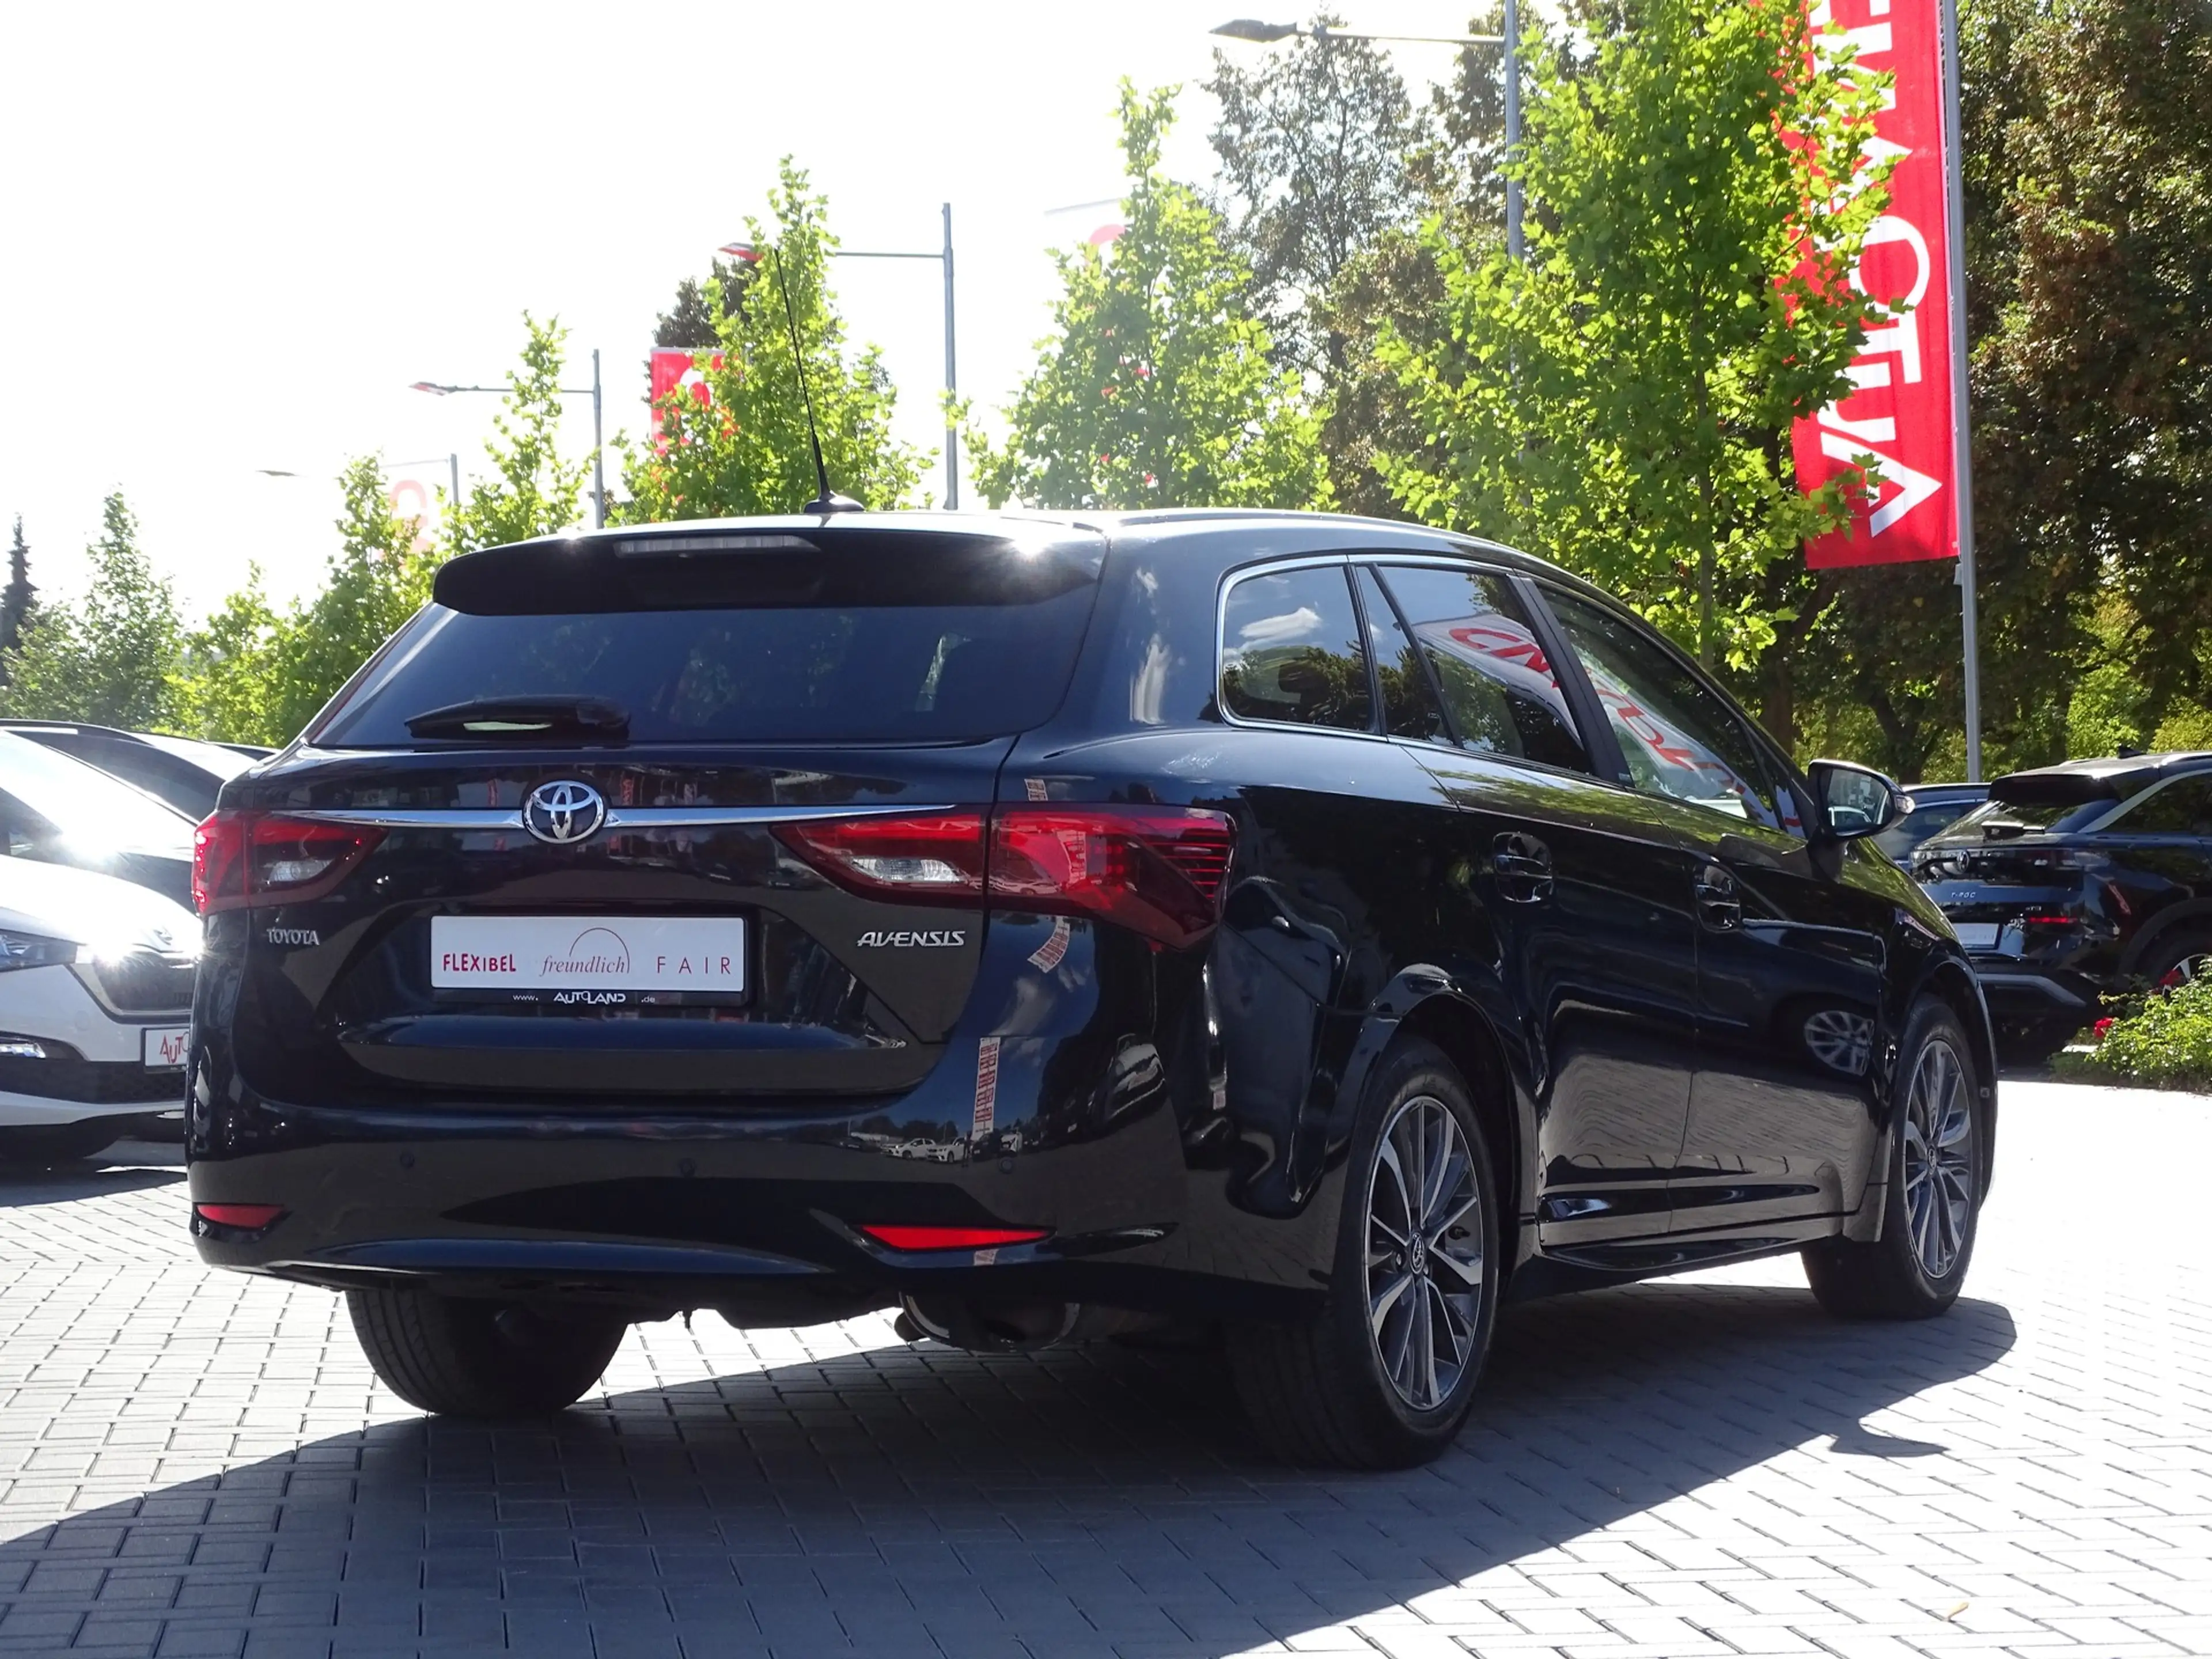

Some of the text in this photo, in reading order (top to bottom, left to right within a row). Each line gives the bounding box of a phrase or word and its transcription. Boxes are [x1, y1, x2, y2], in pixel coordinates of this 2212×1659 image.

[266, 928, 320, 945] TOYOTA
[857, 931, 965, 946] AVENSIS
[442, 953, 517, 972] FLEXIBEL
[539, 955, 626, 977] freundlich
